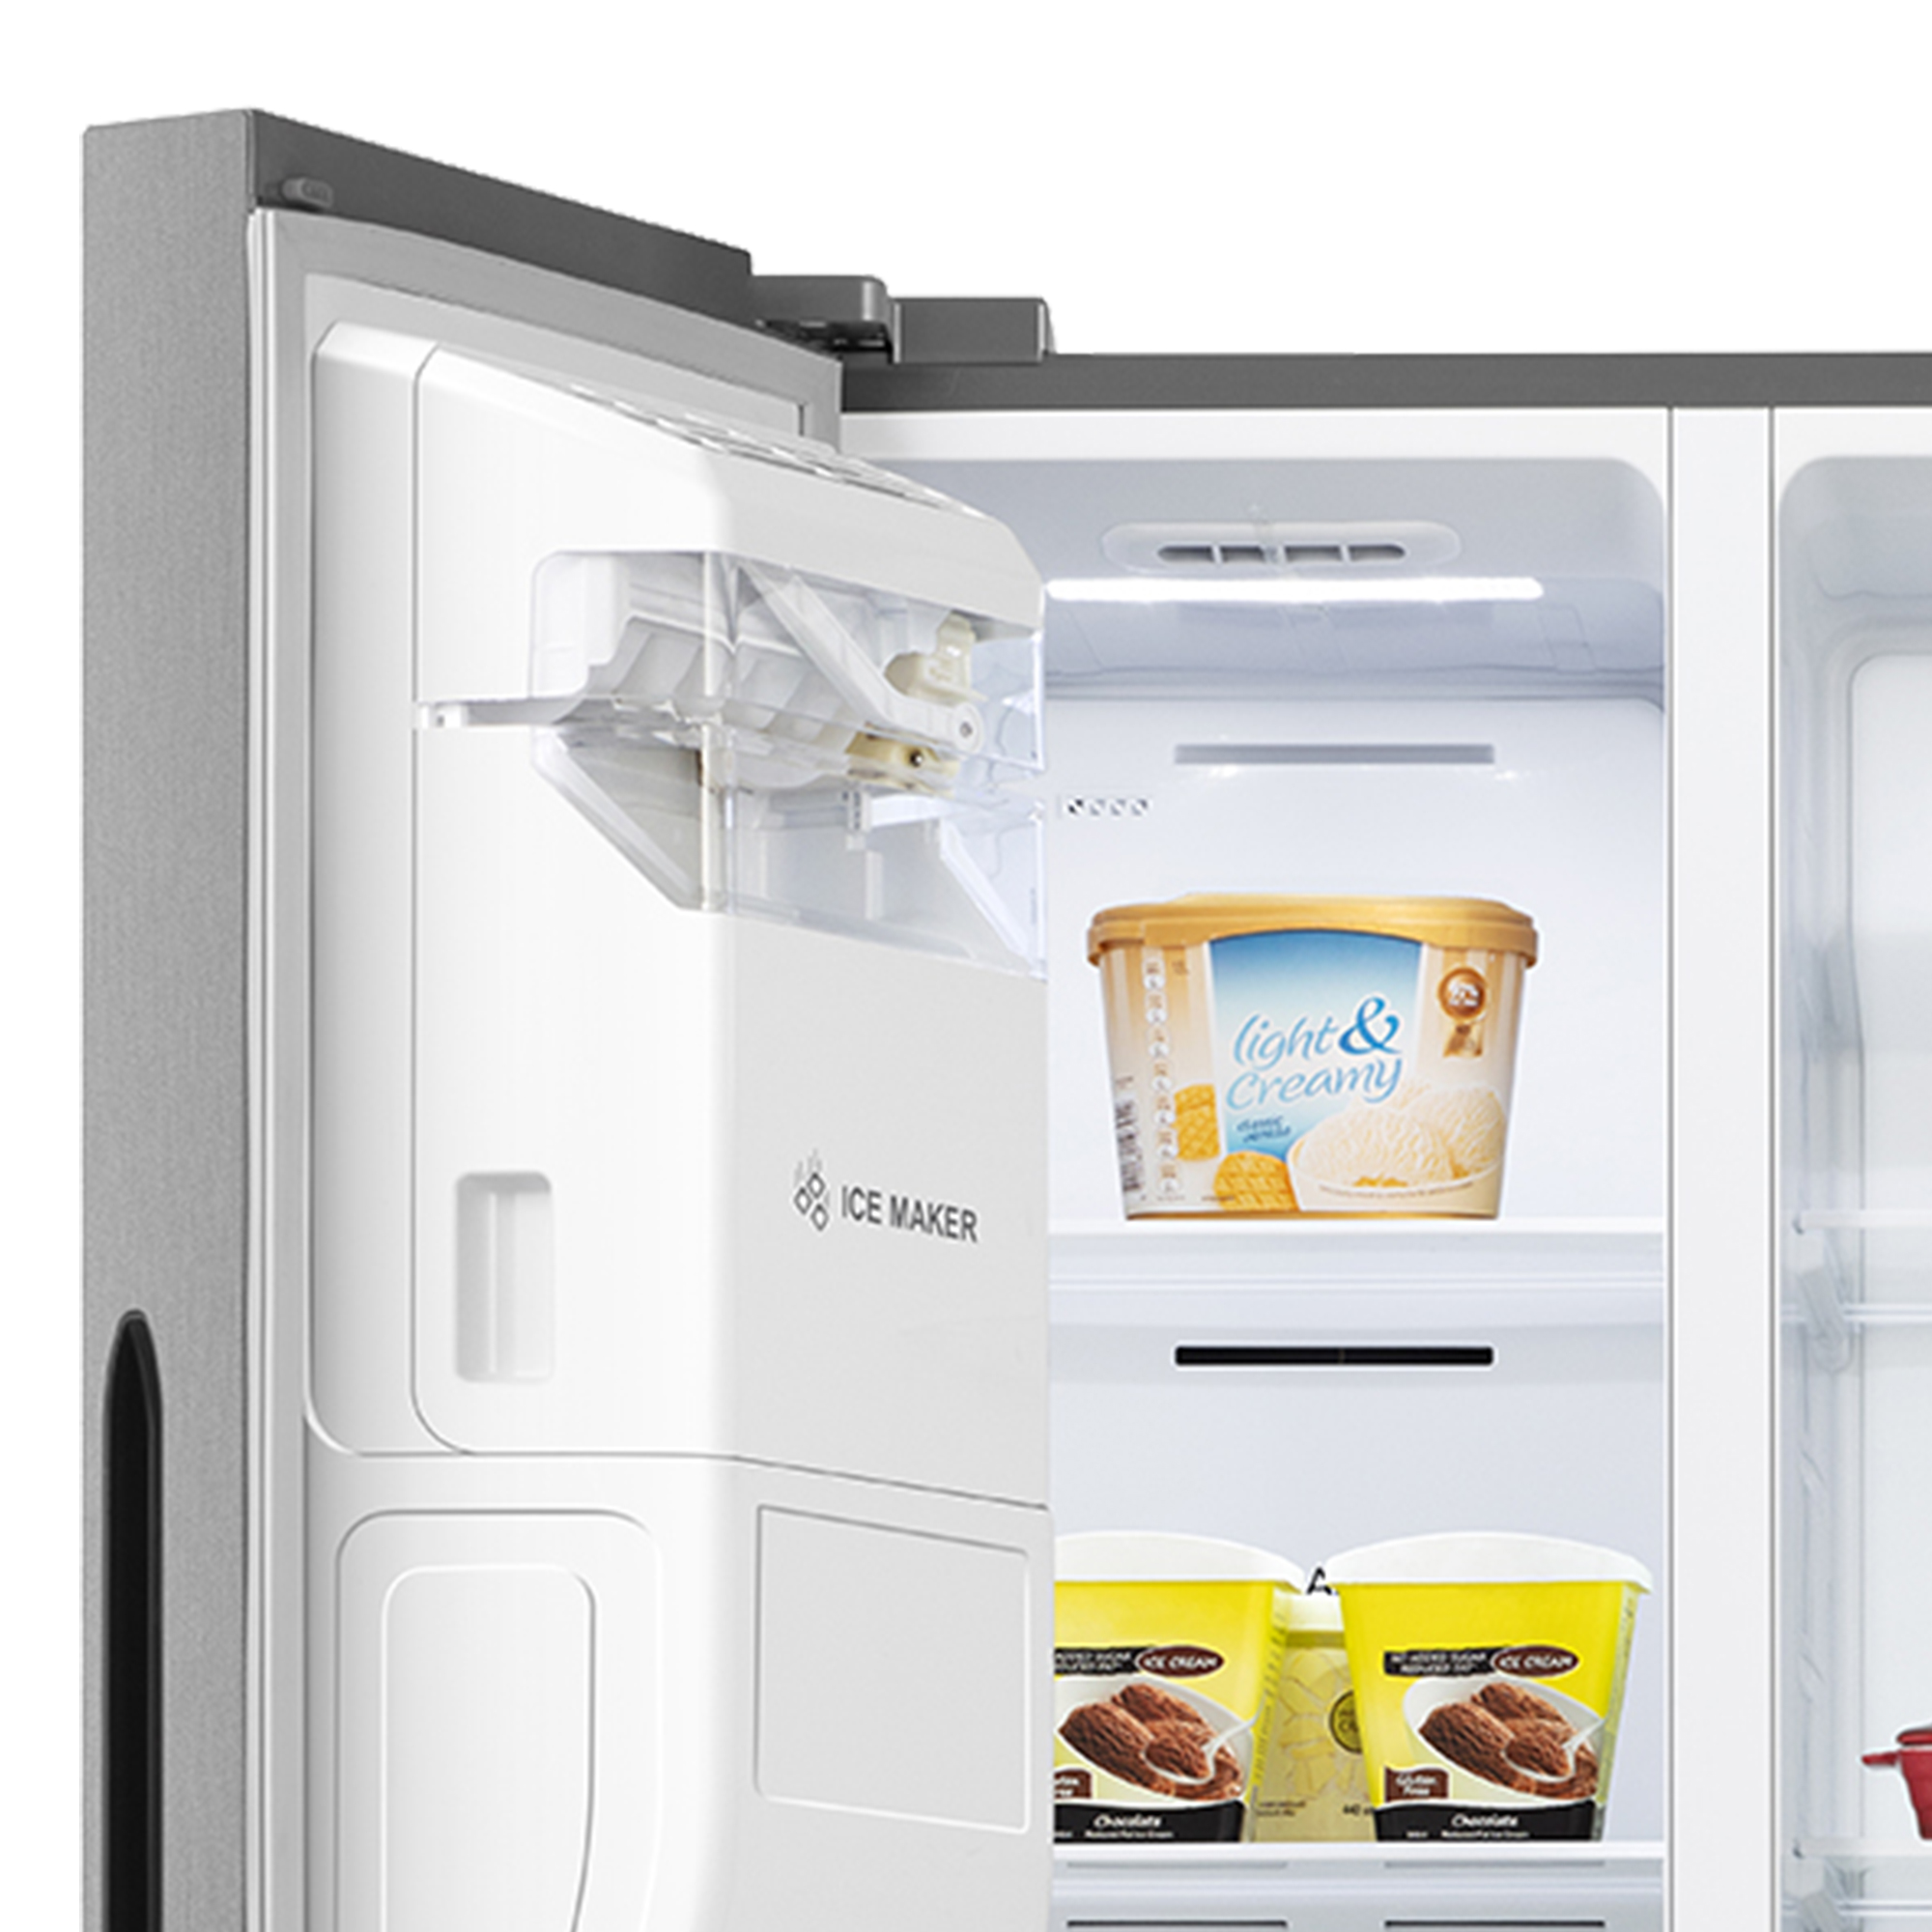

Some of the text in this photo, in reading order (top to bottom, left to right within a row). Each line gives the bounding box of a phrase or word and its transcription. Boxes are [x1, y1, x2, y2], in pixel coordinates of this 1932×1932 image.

[1233, 996, 1402, 1071] light &
[1225, 1057, 1403, 1111] Creamy
[840, 1184, 979, 1244] ICE MAKER
